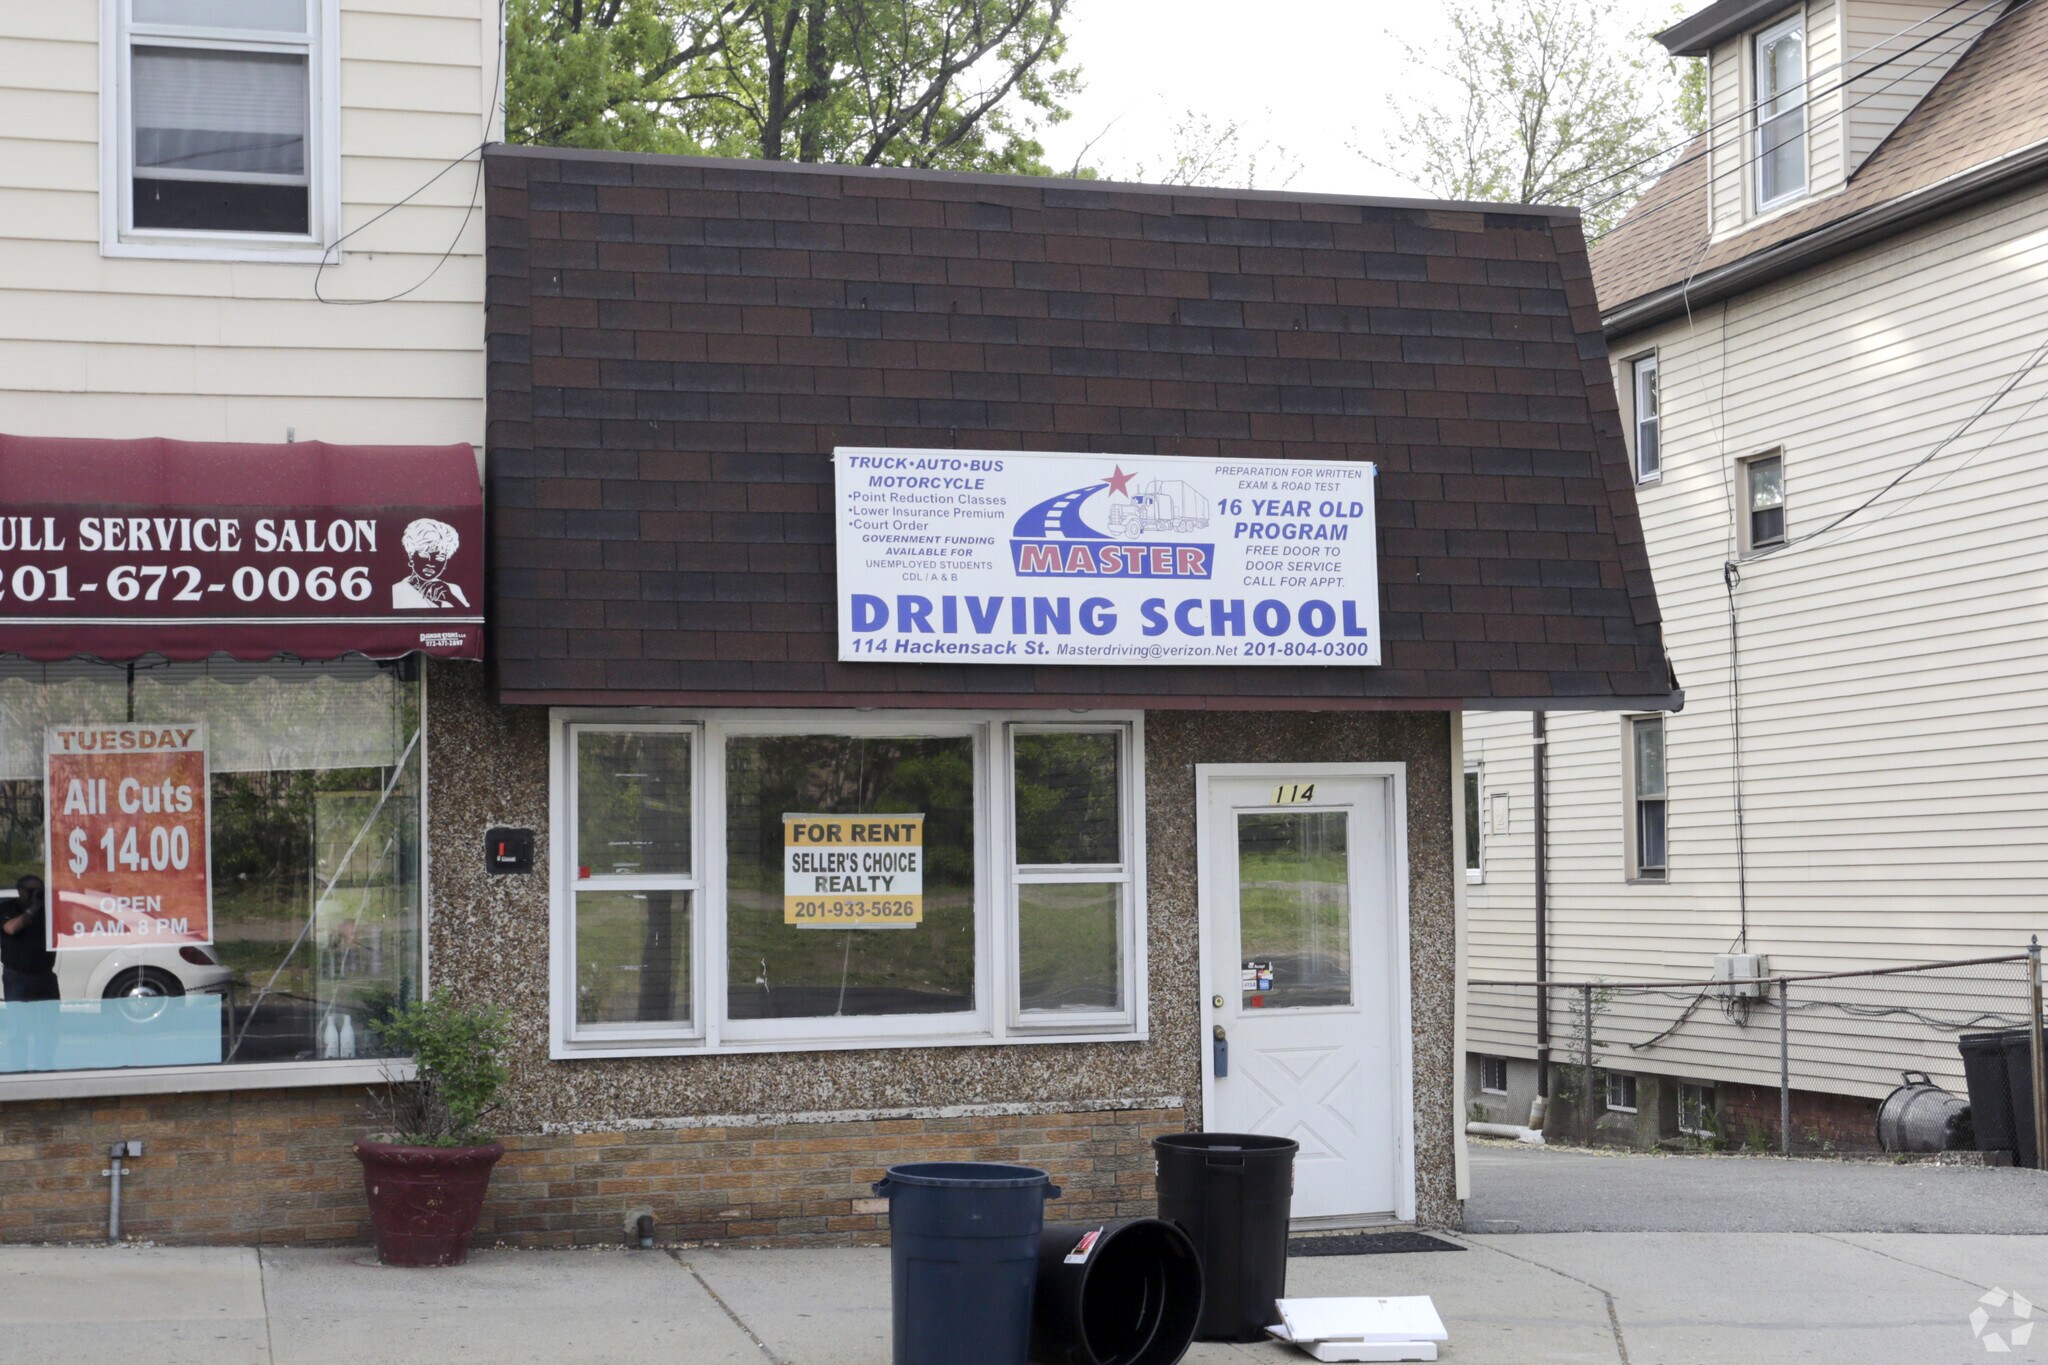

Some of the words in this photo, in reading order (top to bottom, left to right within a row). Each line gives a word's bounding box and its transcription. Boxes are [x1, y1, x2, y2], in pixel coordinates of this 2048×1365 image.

[1215, 466, 1288, 477] PREPARATION
[1291, 468, 1313, 477] FOR
[1316, 468, 1362, 478] WRITTEN
[868, 476, 985, 490] MOTORCYCLE
[1238, 480, 1268, 490] EXAM
[1271, 482, 1278, 490] &
[1281, 482, 1312, 491] ROAD
[1314, 482, 1341, 492] TEST
[890, 492, 954, 504] Reduction
[958, 494, 1007, 506] Classes
[1217, 498, 1242, 516] 16
[1251, 499, 1312, 517] YEAR
[1319, 500, 1364, 518] OLD
[892, 506, 950, 518] Insurance
[954, 508, 1005, 519] Premium
[79, 517, 242, 552] SERVICE
[255, 519, 378, 552] SALON
[892, 520, 928, 531] Order
[1234, 522, 1348, 541] PROGRAM
[862, 534, 941, 544] GOVERNMENT
[944, 536, 995, 545] FUNDING
[886, 547, 947, 556] AVAILABLE
[950, 548, 973, 557] FOR
[1018, 544, 1208, 576] MASTER
[1245, 545, 1279, 556] FREE
[1282, 546, 1320, 556] DOOR
[1324, 546, 1341, 557] TO
[866, 560, 936, 569] UNEMPLOYED
[940, 561, 993, 570] STUDENTS
[1245, 560, 1283, 571] DOOR
[1287, 562, 1342, 572] SERVICE
[0, 564, 373, 602] 01-672-0066
[902, 572, 922, 582] CDL
[931, 573, 938, 582] A
[942, 574, 948, 582] &
[951, 574, 958, 582] B
[1243, 576, 1276, 586] CALL
[1280, 576, 1307, 587] FOR
[1310, 577, 1345, 588] APPT.
[850, 594, 1118, 636] DRIVING
[1140, 597, 1368, 638] SCHOOL
[852, 638, 888, 654] 114
[894, 639, 1017, 655] Hackensack
[1024, 640, 1050, 656] St.
[1056, 643, 1238, 659] Masterdriving@verizon.Net
[1244, 642, 1368, 657] 201-804-0300
[57, 728, 195, 750] TUESDAY
[63, 778, 107, 816] All
[118, 776, 193, 815] Cuts
[1276, 783, 1315, 804] 114
[793, 824, 842, 843] FOR
[851, 824, 916, 842] RENT
[68, 826, 89, 880] $
[100, 825, 190, 873] 14.00
[792, 852, 858, 874] SELLER'S
[863, 852, 917, 873] CHOICE
[815, 875, 894, 894] REALTY
[100, 895, 161, 914] OPEN
[795, 901, 914, 918] 201-933-5626
[72, 921, 86, 938] 9
[138, 919, 148, 936] 8
[156, 917, 188, 936] PM
